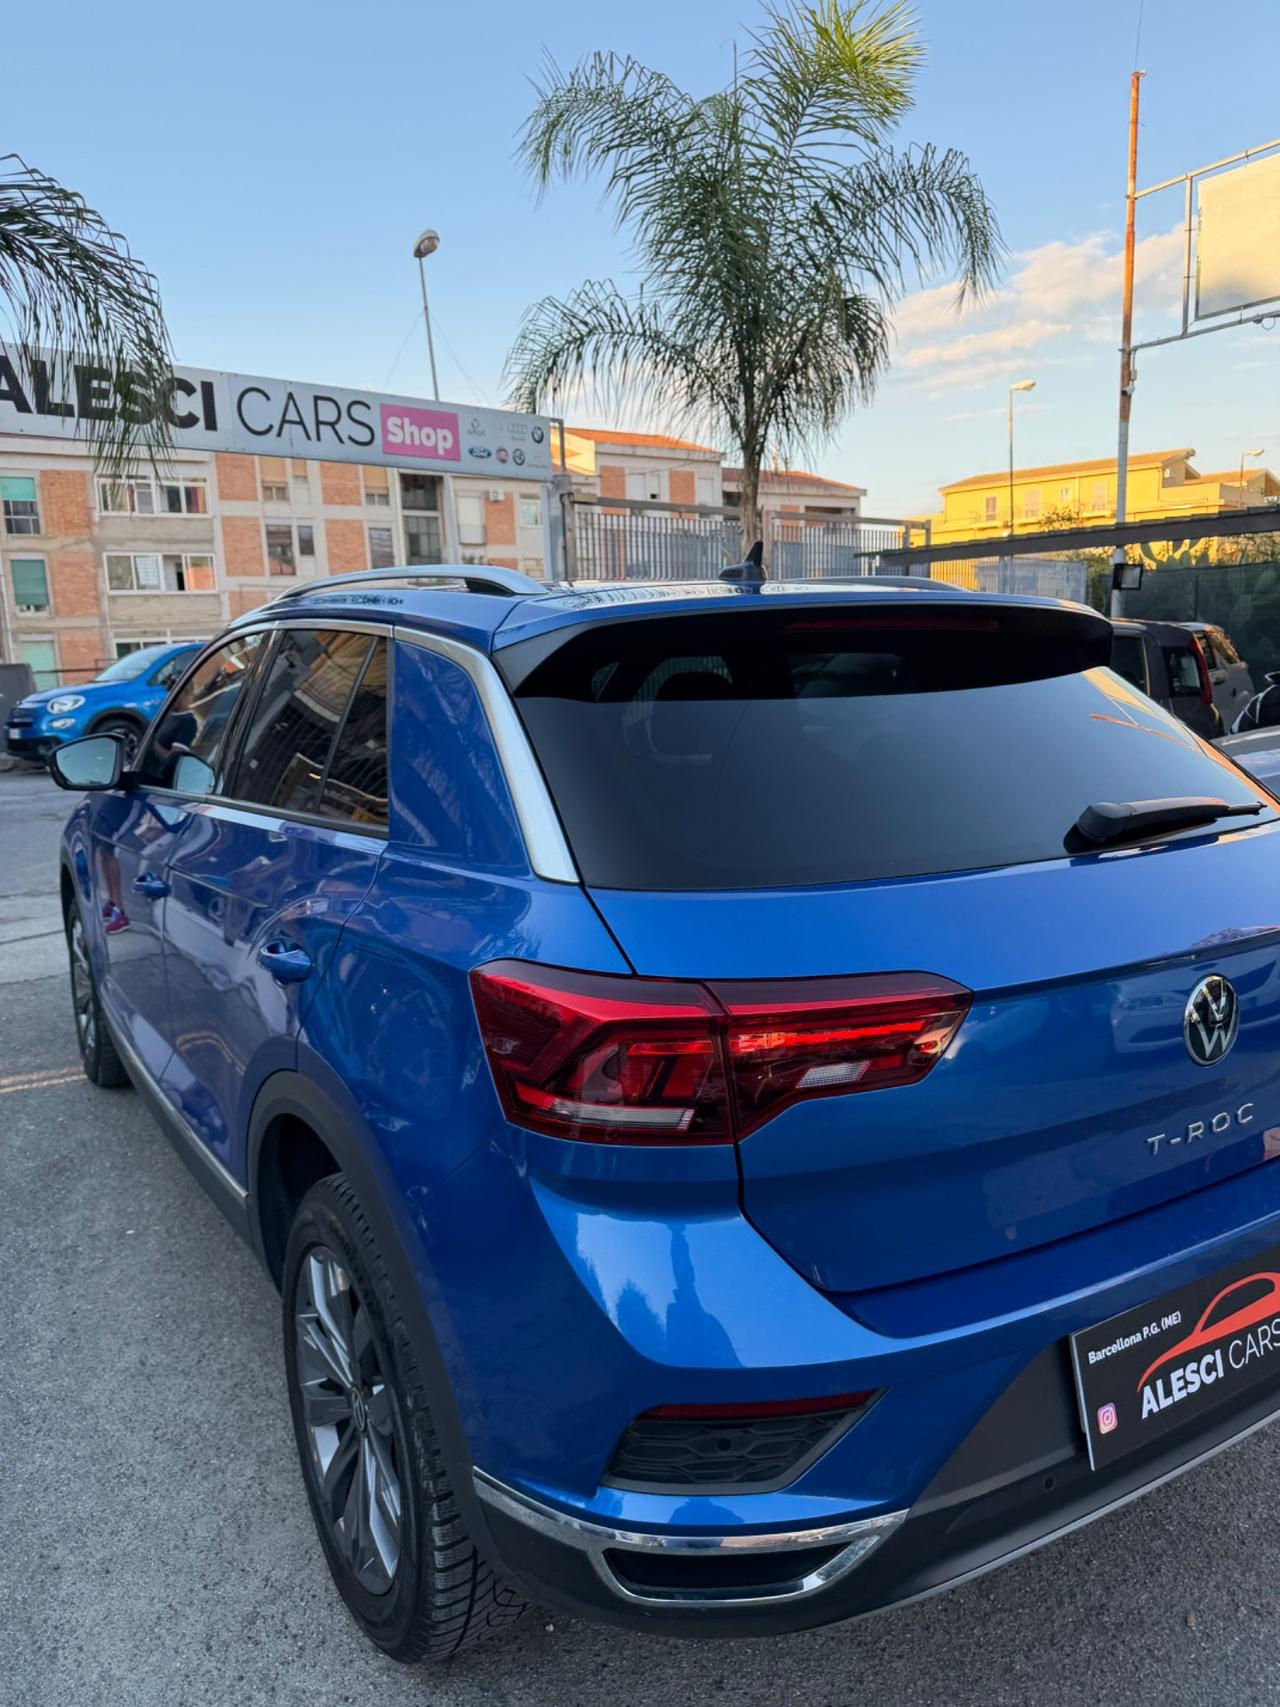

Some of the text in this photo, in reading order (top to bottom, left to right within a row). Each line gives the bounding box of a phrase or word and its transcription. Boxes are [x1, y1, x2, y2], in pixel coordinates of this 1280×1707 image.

[236, 386, 376, 447] CARS
[386, 416, 454, 456] Shop
[1146, 1102, 1255, 1156] T-ROC
[1087, 1310, 1182, 1364] Barcellona P.G. (ME)
[1141, 1348, 1224, 1420] ALESCI
